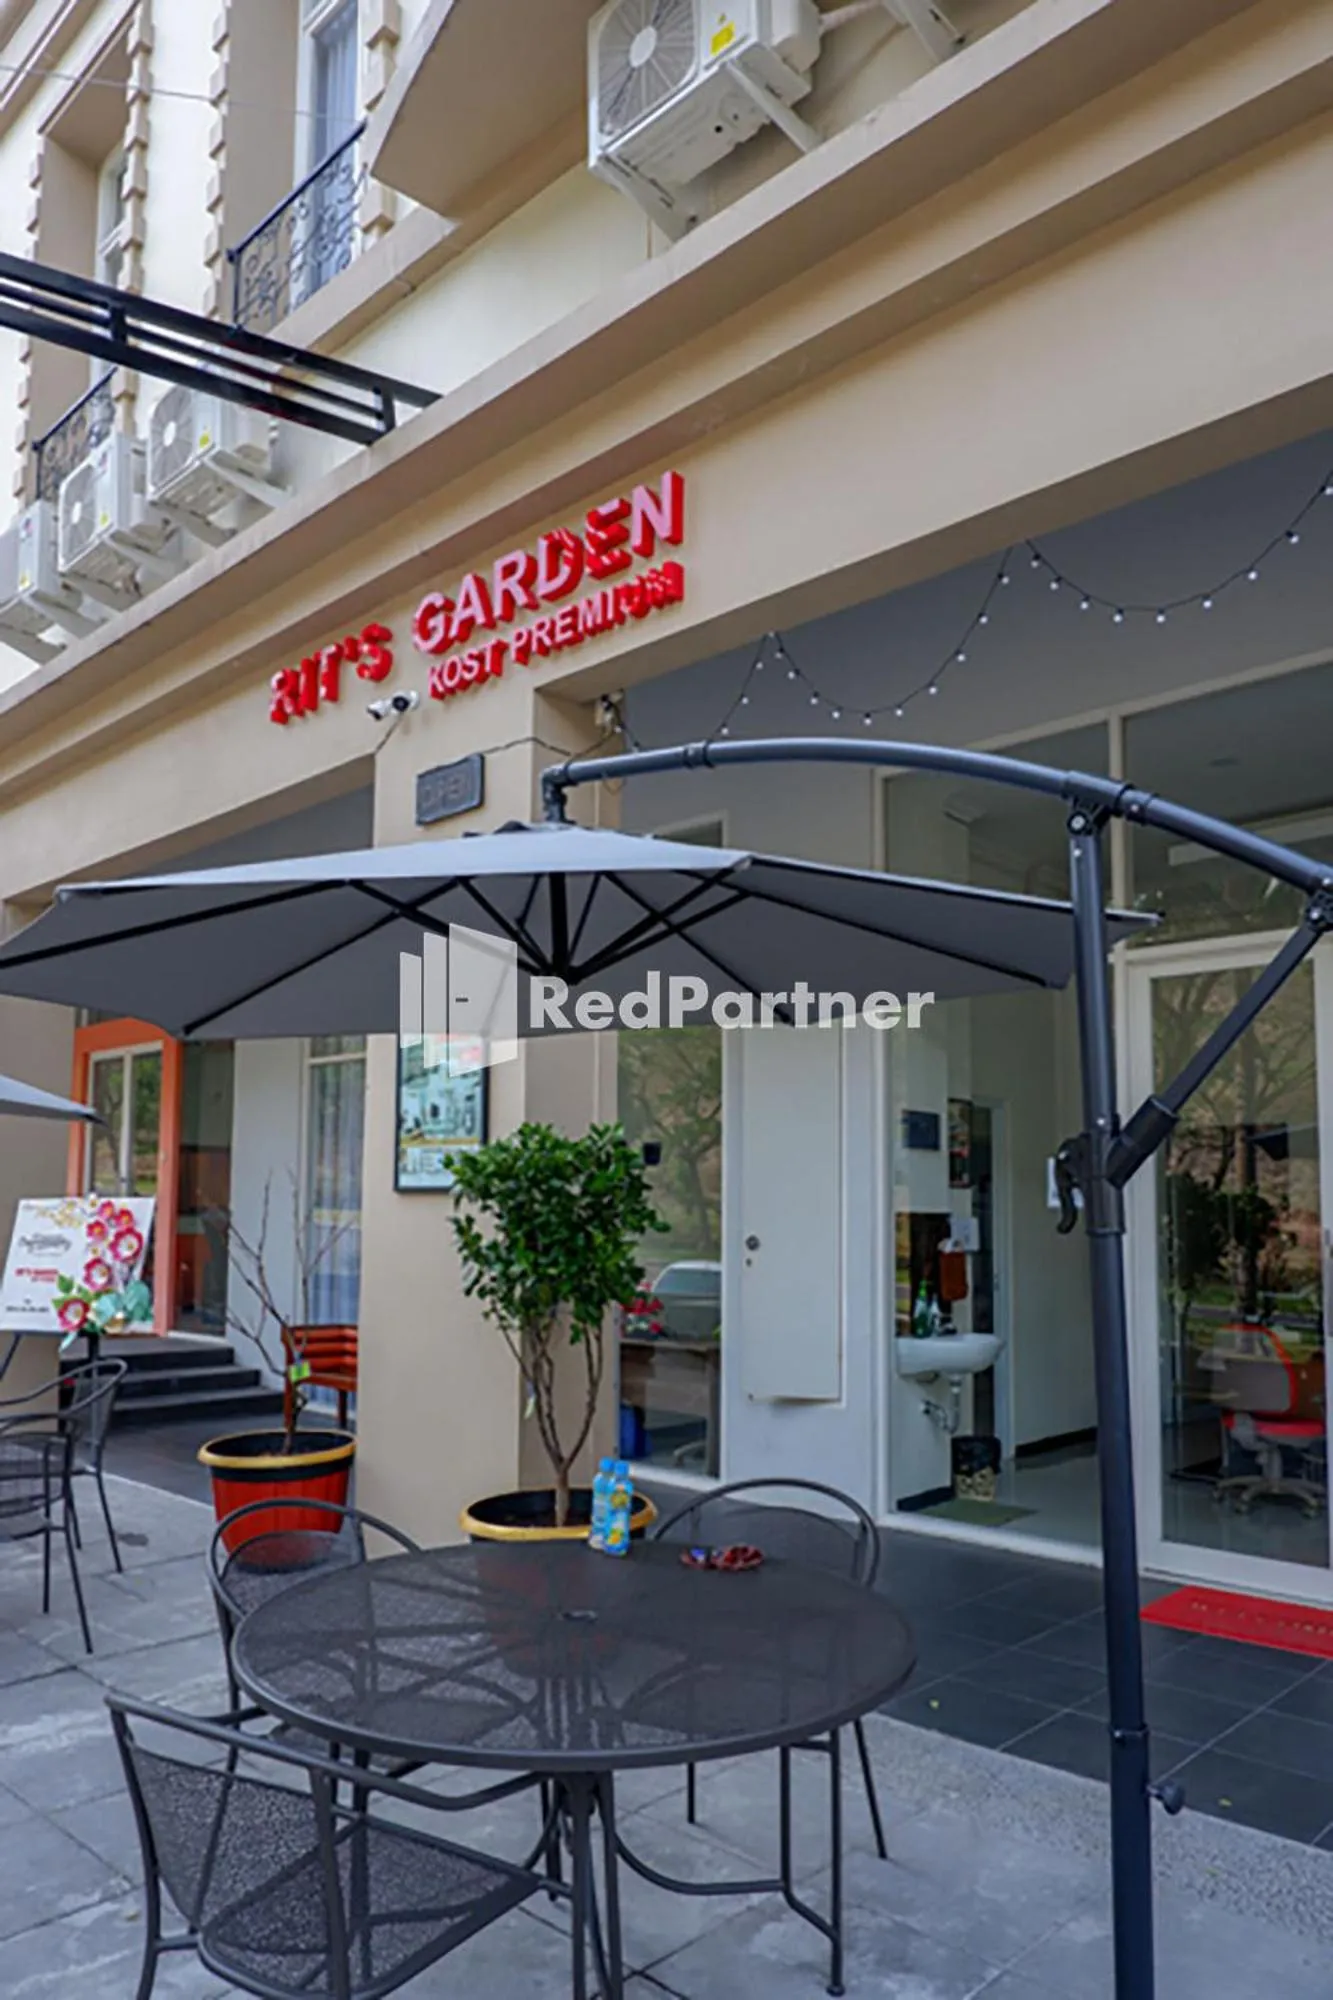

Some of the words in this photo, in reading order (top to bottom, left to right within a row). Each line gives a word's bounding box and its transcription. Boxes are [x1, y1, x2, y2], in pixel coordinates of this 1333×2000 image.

[270, 622, 393, 725] RIT'S
[412, 470, 685, 655] GARDEN
[427, 638, 510, 701] KOST
[511, 560, 685, 667] PREMIUM
